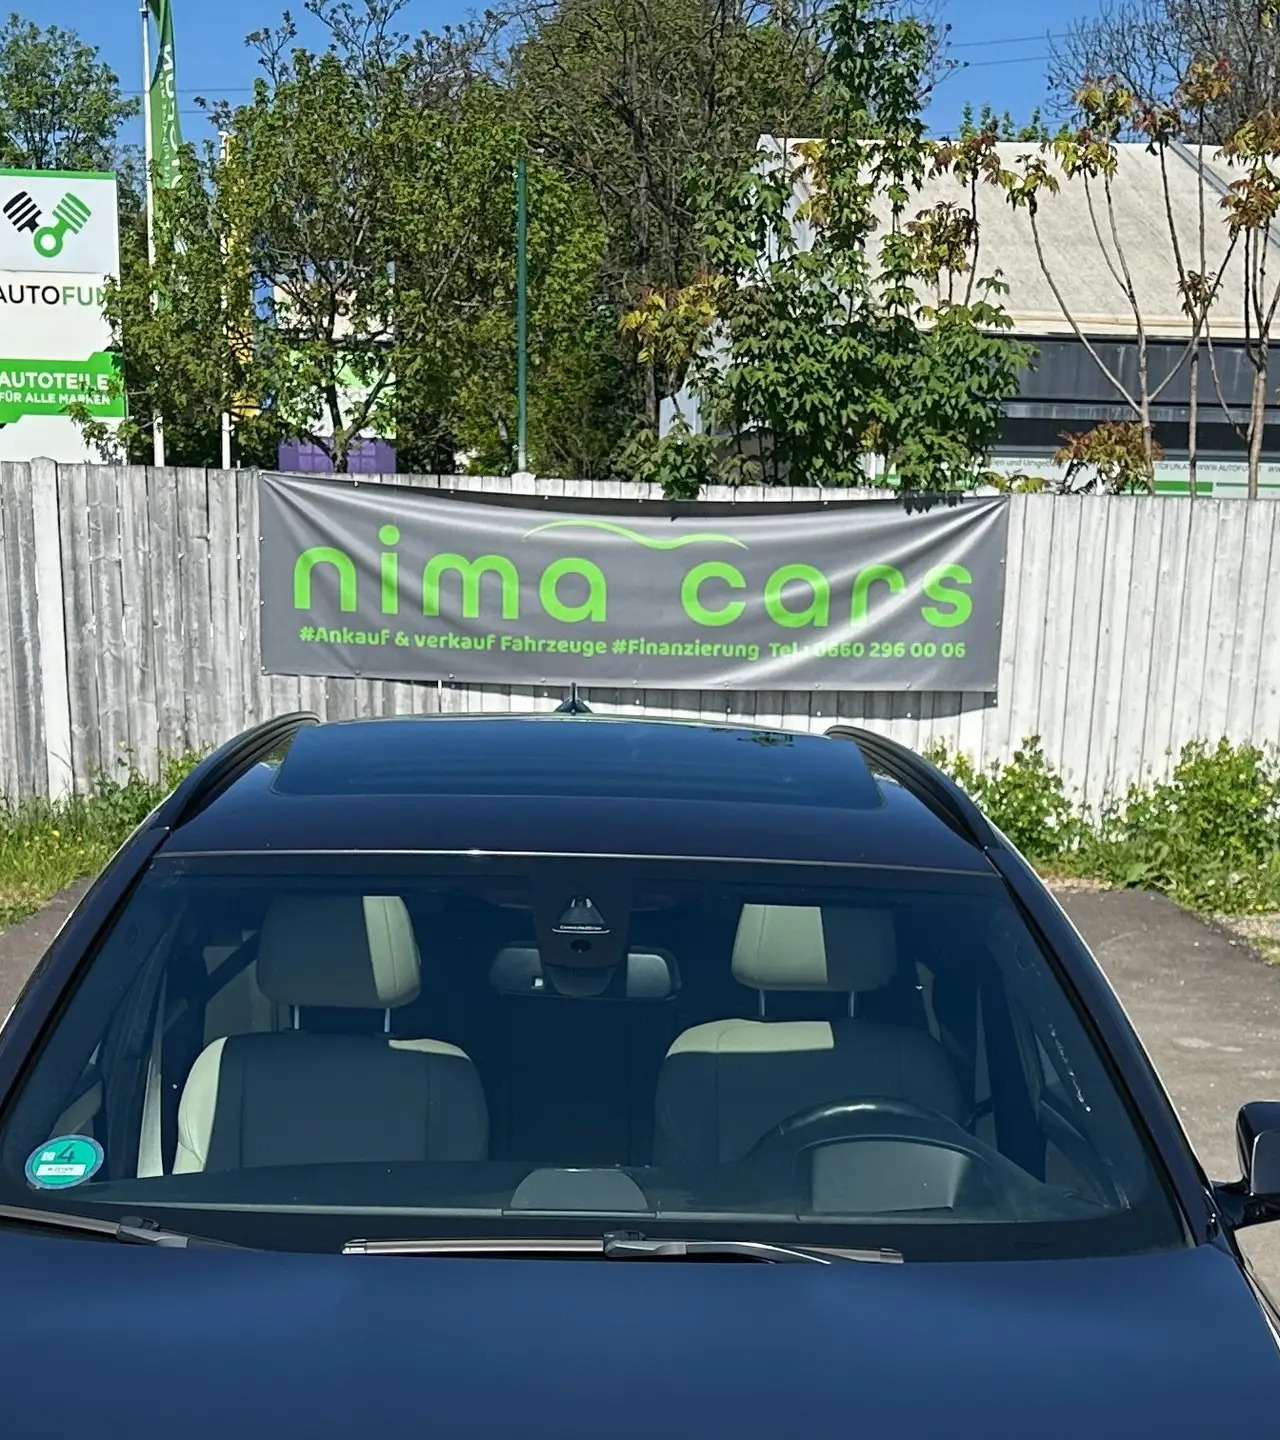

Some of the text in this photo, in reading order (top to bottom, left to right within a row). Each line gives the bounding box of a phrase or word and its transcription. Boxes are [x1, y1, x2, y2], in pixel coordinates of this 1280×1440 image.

[25, 392, 56, 403] ALLE
[59, 393, 111, 405] MARKEN
[293, 524, 972, 628] nima cars
[299, 625, 390, 646] #Ankauf
[394, 630, 409, 647] &
[414, 632, 495, 650] verkauf
[500, 636, 607, 657] Fahrzeuge
[612, 638, 760, 661] #Finanzierung
[815, 642, 865, 658] 0660
[869, 643, 906, 658] 296
[910, 643, 937, 658] 00
[941, 643, 966, 658] 06
[56, 1142, 76, 1162] 4
